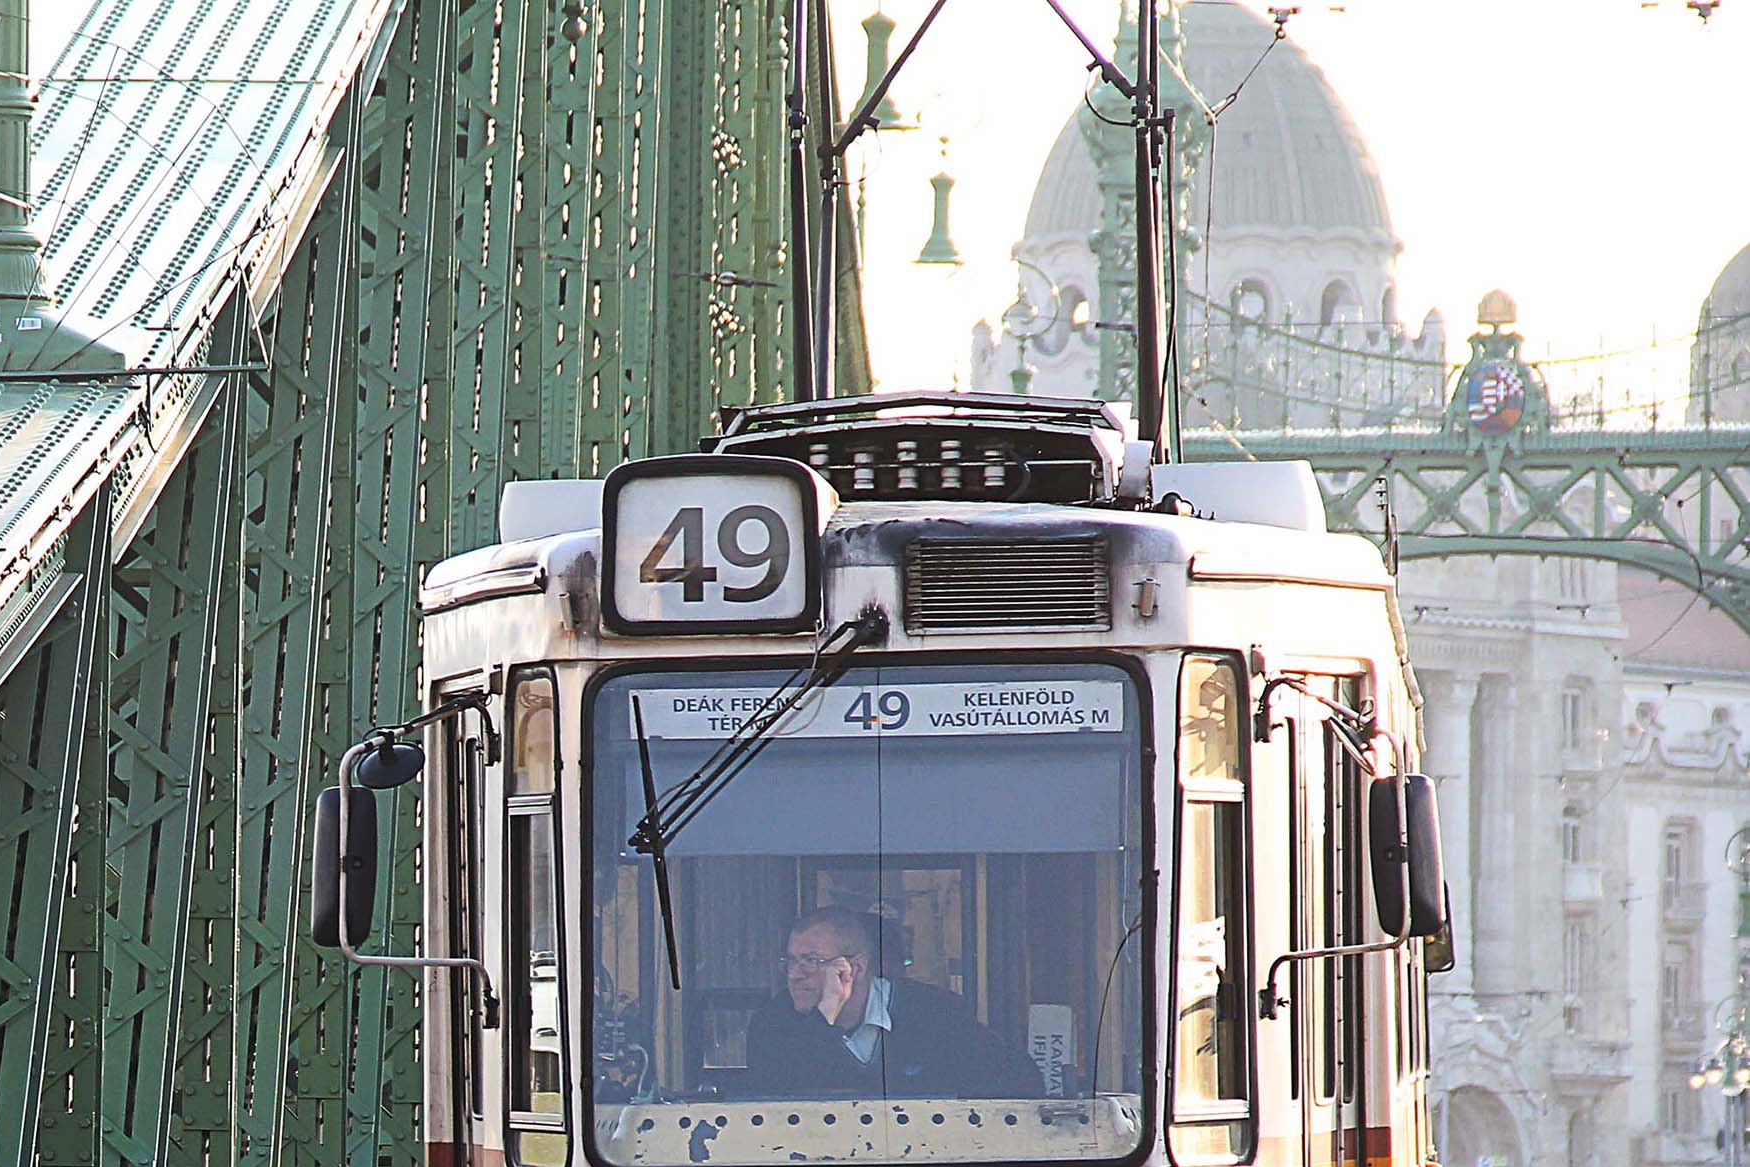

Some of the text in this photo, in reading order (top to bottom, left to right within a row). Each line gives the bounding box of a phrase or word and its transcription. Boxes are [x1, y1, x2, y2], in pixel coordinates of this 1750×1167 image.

[639, 504, 790, 603] 49
[673, 694, 724, 712] DEÁK
[964, 688, 1075, 707] KELENFÖLD
[844, 690, 911, 731] 49
[929, 707, 1109, 727] VASÚTÁLLOMÁS M
[708, 714, 744, 731] TÉR
[1051, 1034, 1063, 1095] KAMA
